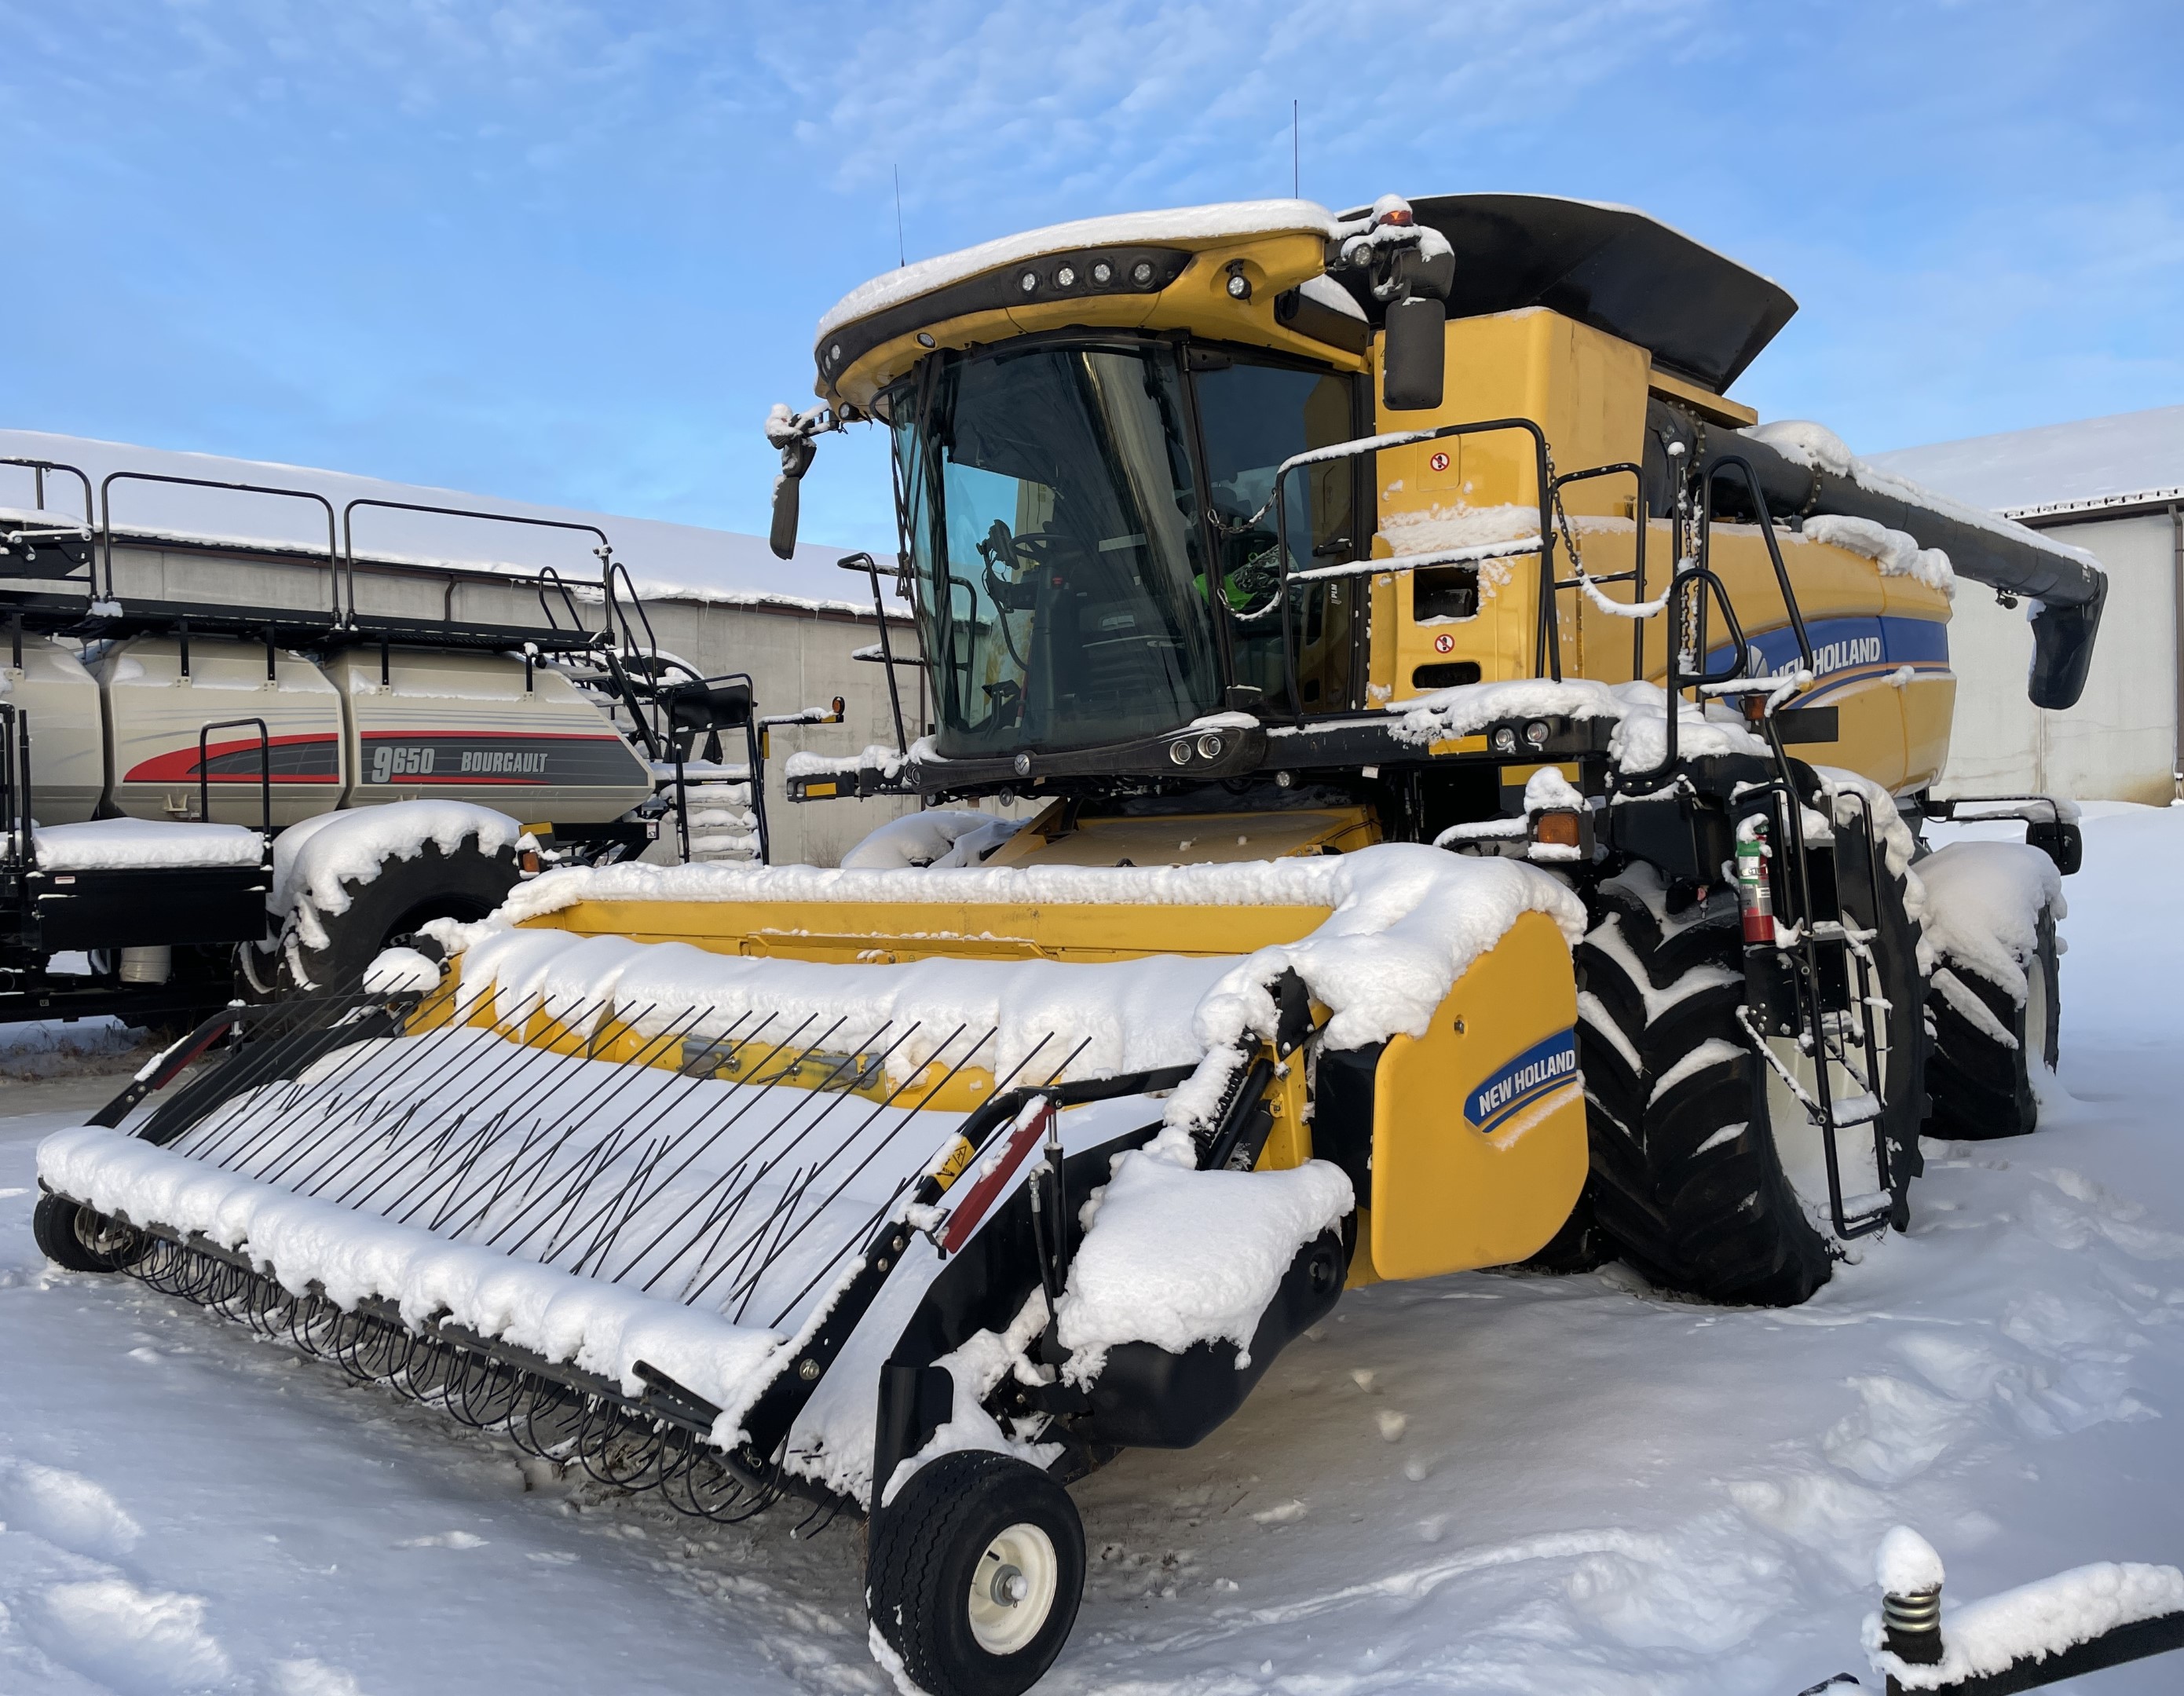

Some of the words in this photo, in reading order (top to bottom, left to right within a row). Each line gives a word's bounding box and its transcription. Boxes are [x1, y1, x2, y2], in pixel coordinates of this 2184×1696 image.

[1812, 637, 1881, 678] HOLLAND
[371, 746, 435, 784] 9650
[460, 751, 548, 773] BOURGAULT
[1479, 1076, 1513, 1117] NEW
[1514, 1049, 1575, 1094] HOLLAND
